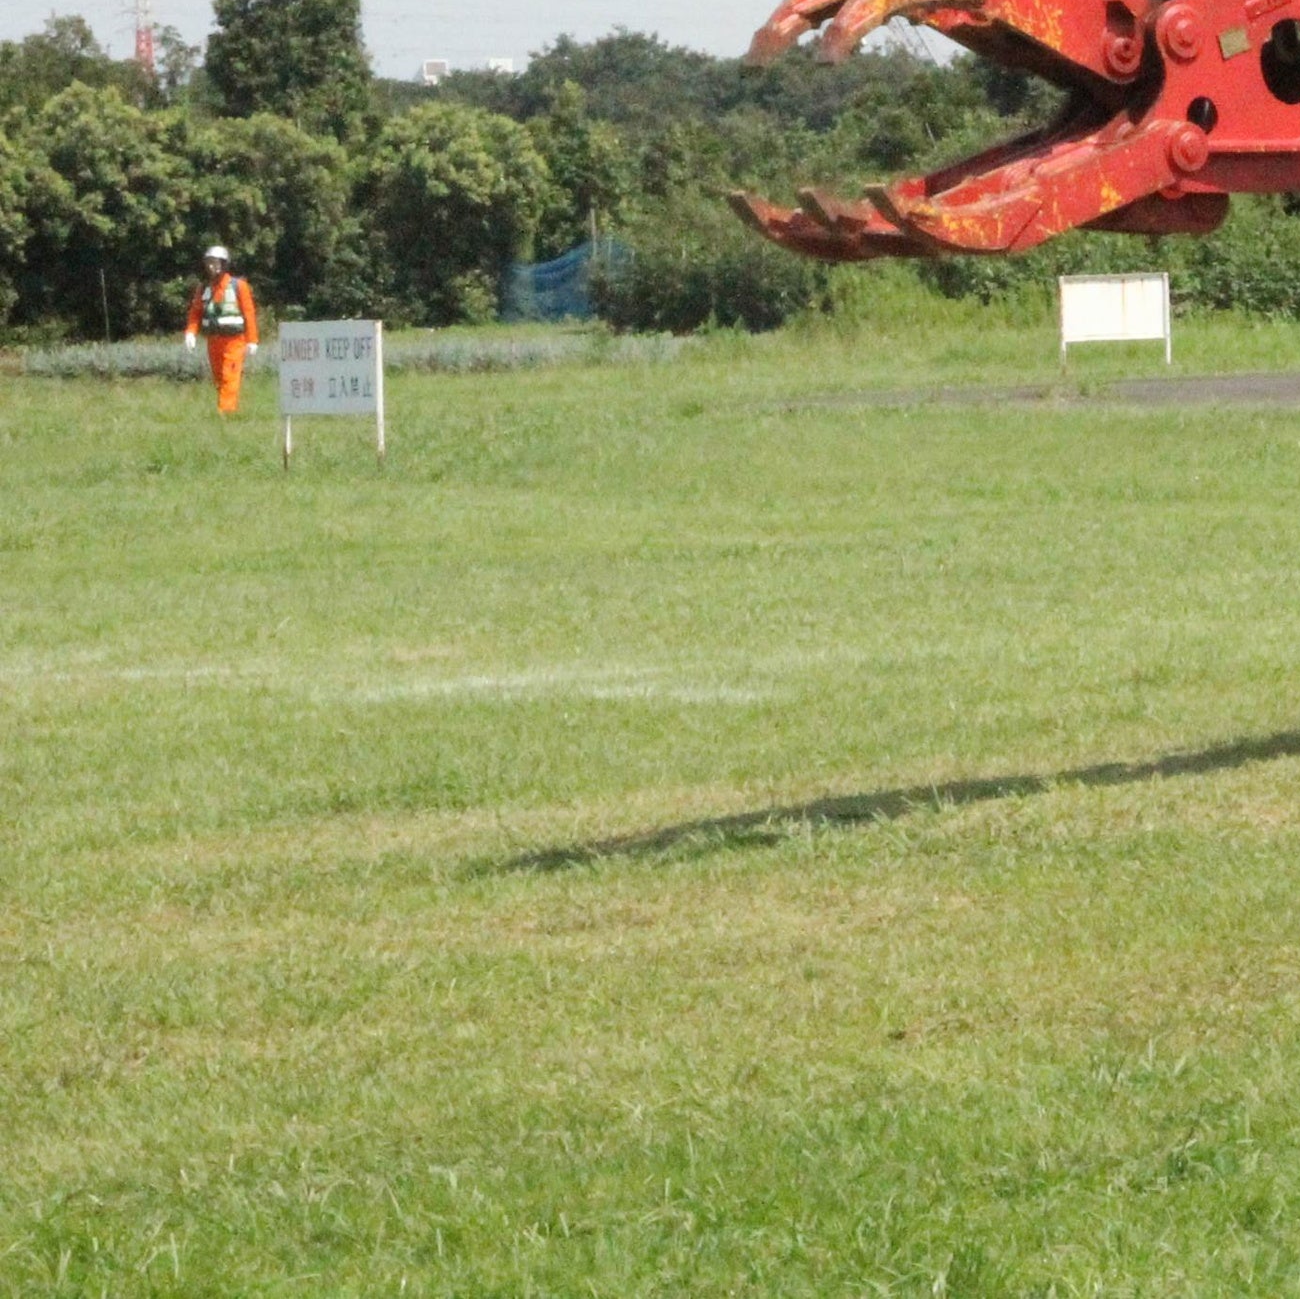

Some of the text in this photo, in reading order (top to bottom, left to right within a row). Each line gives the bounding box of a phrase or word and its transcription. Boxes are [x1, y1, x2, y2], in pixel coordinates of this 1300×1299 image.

[281, 335, 374, 361] DANGER KEEP OFF
